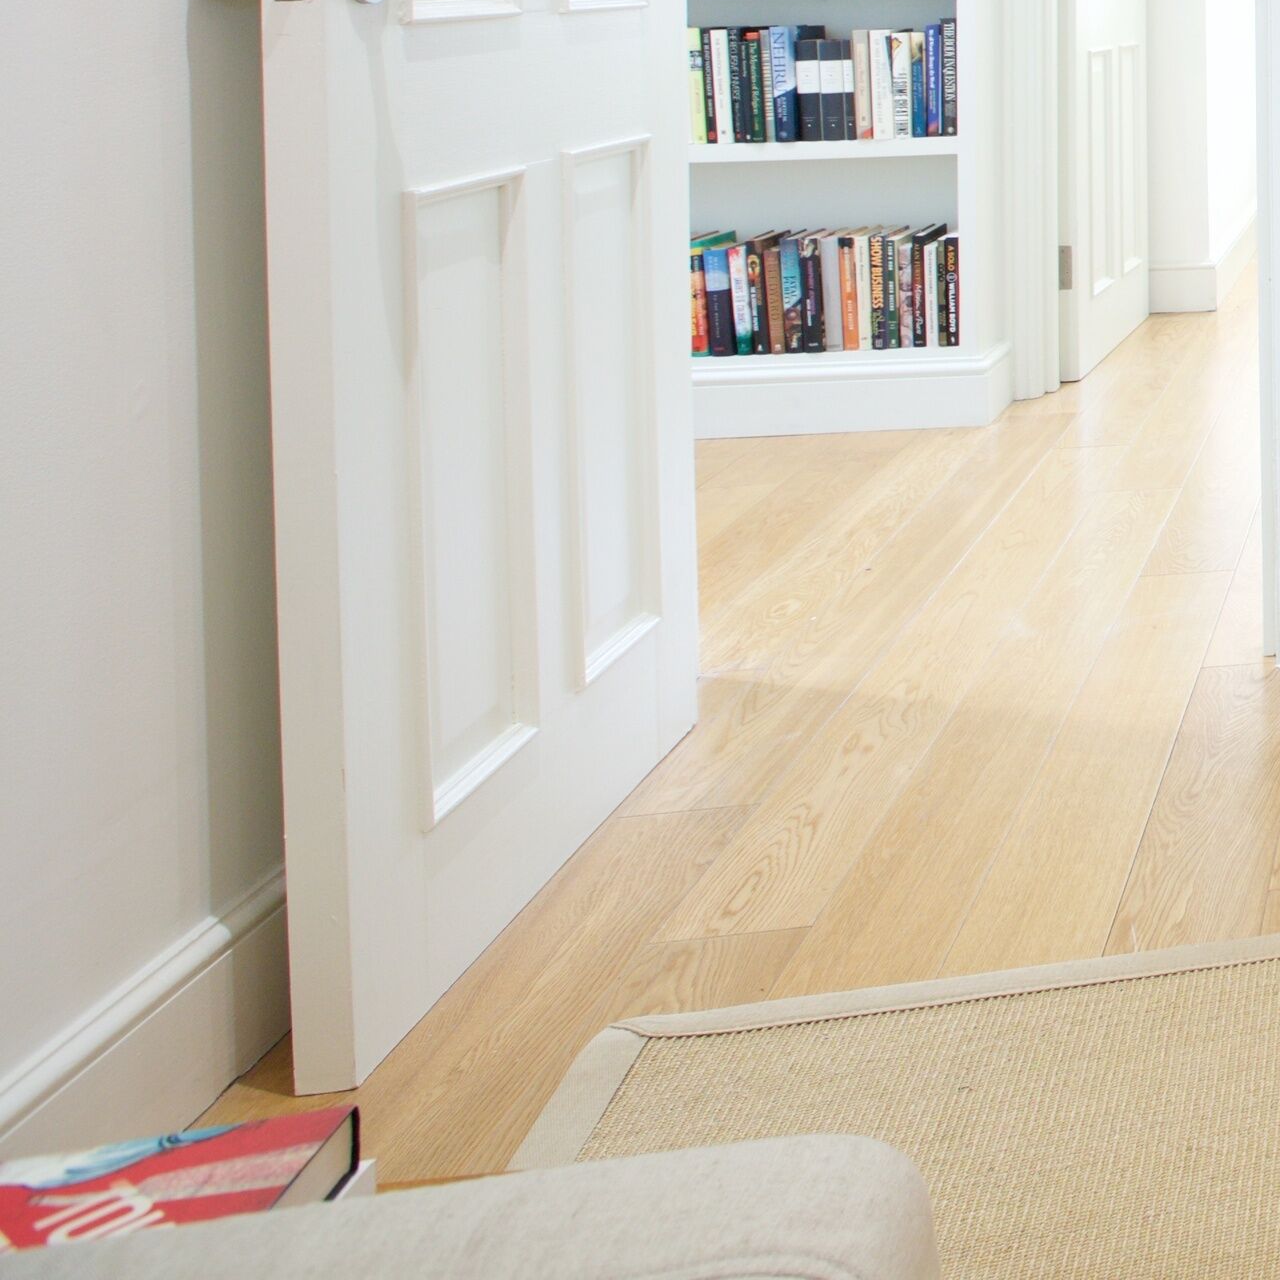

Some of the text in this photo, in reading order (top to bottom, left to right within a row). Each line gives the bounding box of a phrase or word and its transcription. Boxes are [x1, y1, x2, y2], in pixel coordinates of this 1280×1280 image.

[772, 31, 786, 93] NEHRU
[870, 237, 883, 308] SHOW BUSINESS
